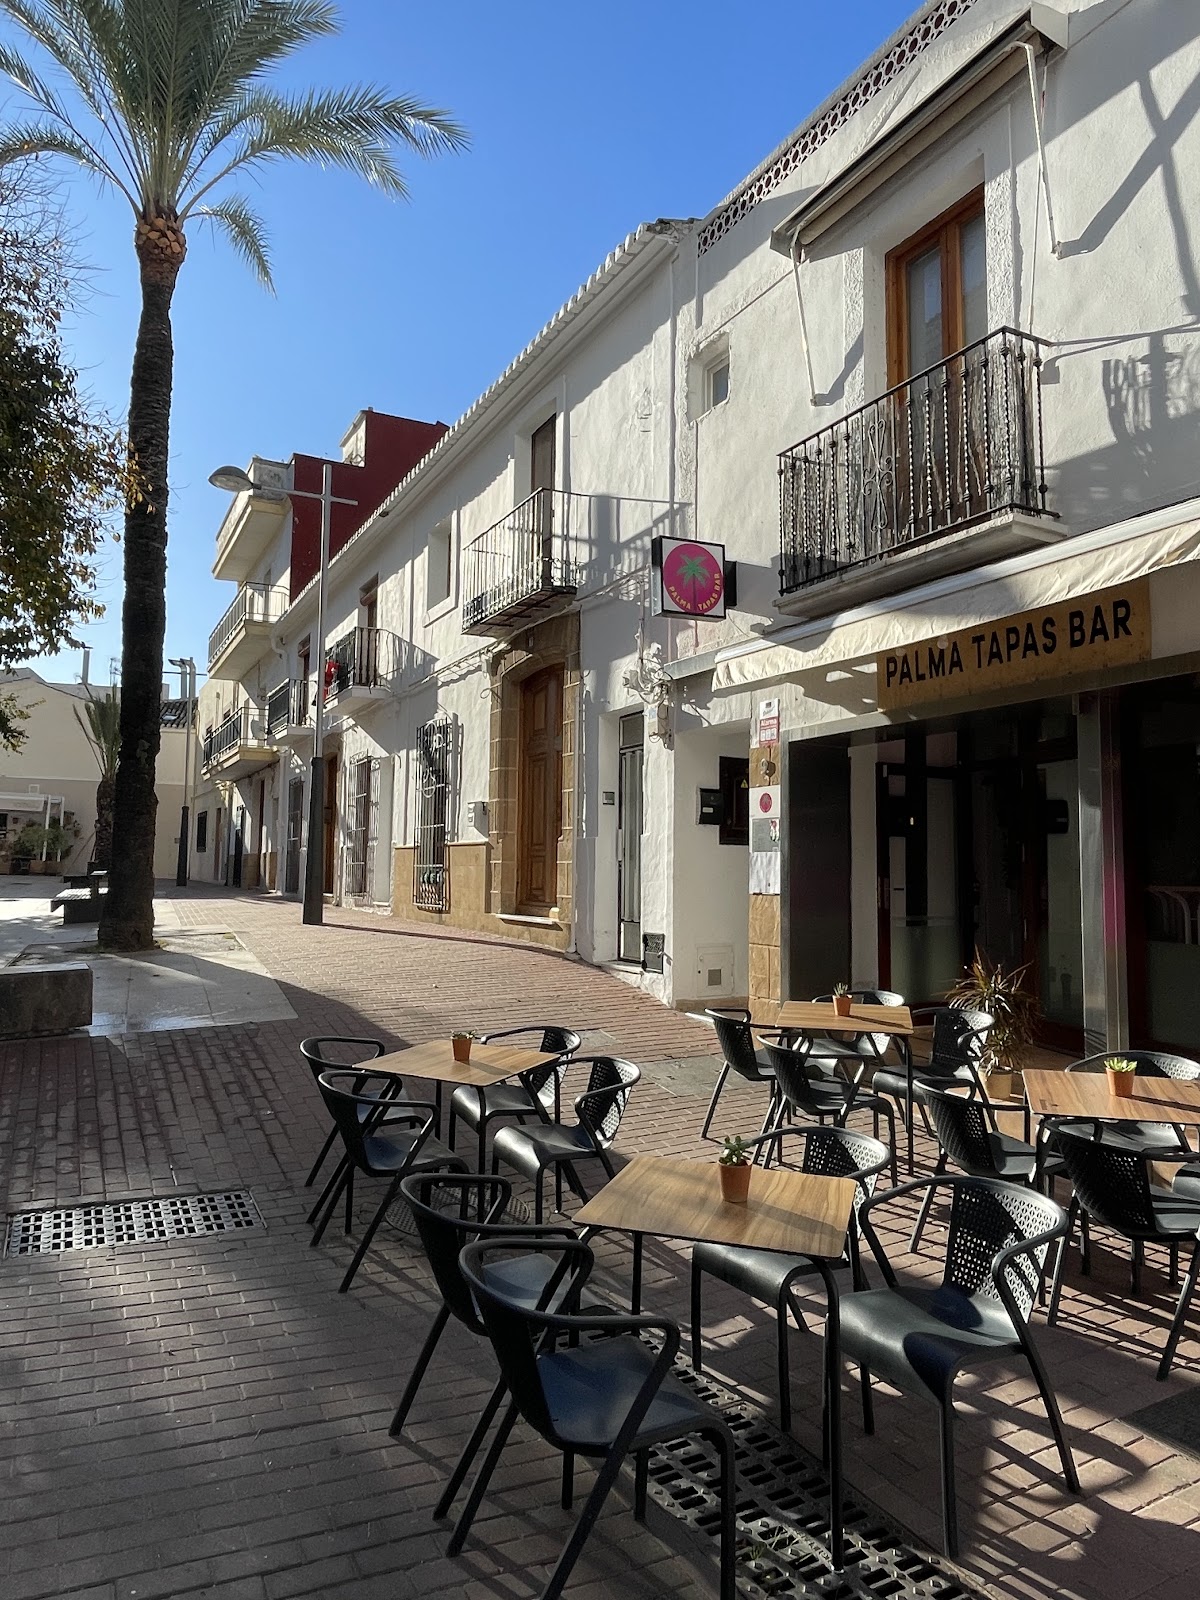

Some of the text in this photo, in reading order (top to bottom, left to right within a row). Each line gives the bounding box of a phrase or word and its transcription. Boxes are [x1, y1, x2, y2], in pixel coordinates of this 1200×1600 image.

[668, 573, 722, 611] PALMA TAPAS BAR
[885, 598, 1133, 688] PALMA TAPAS BAR
[760, 718, 777, 727] Alarma
